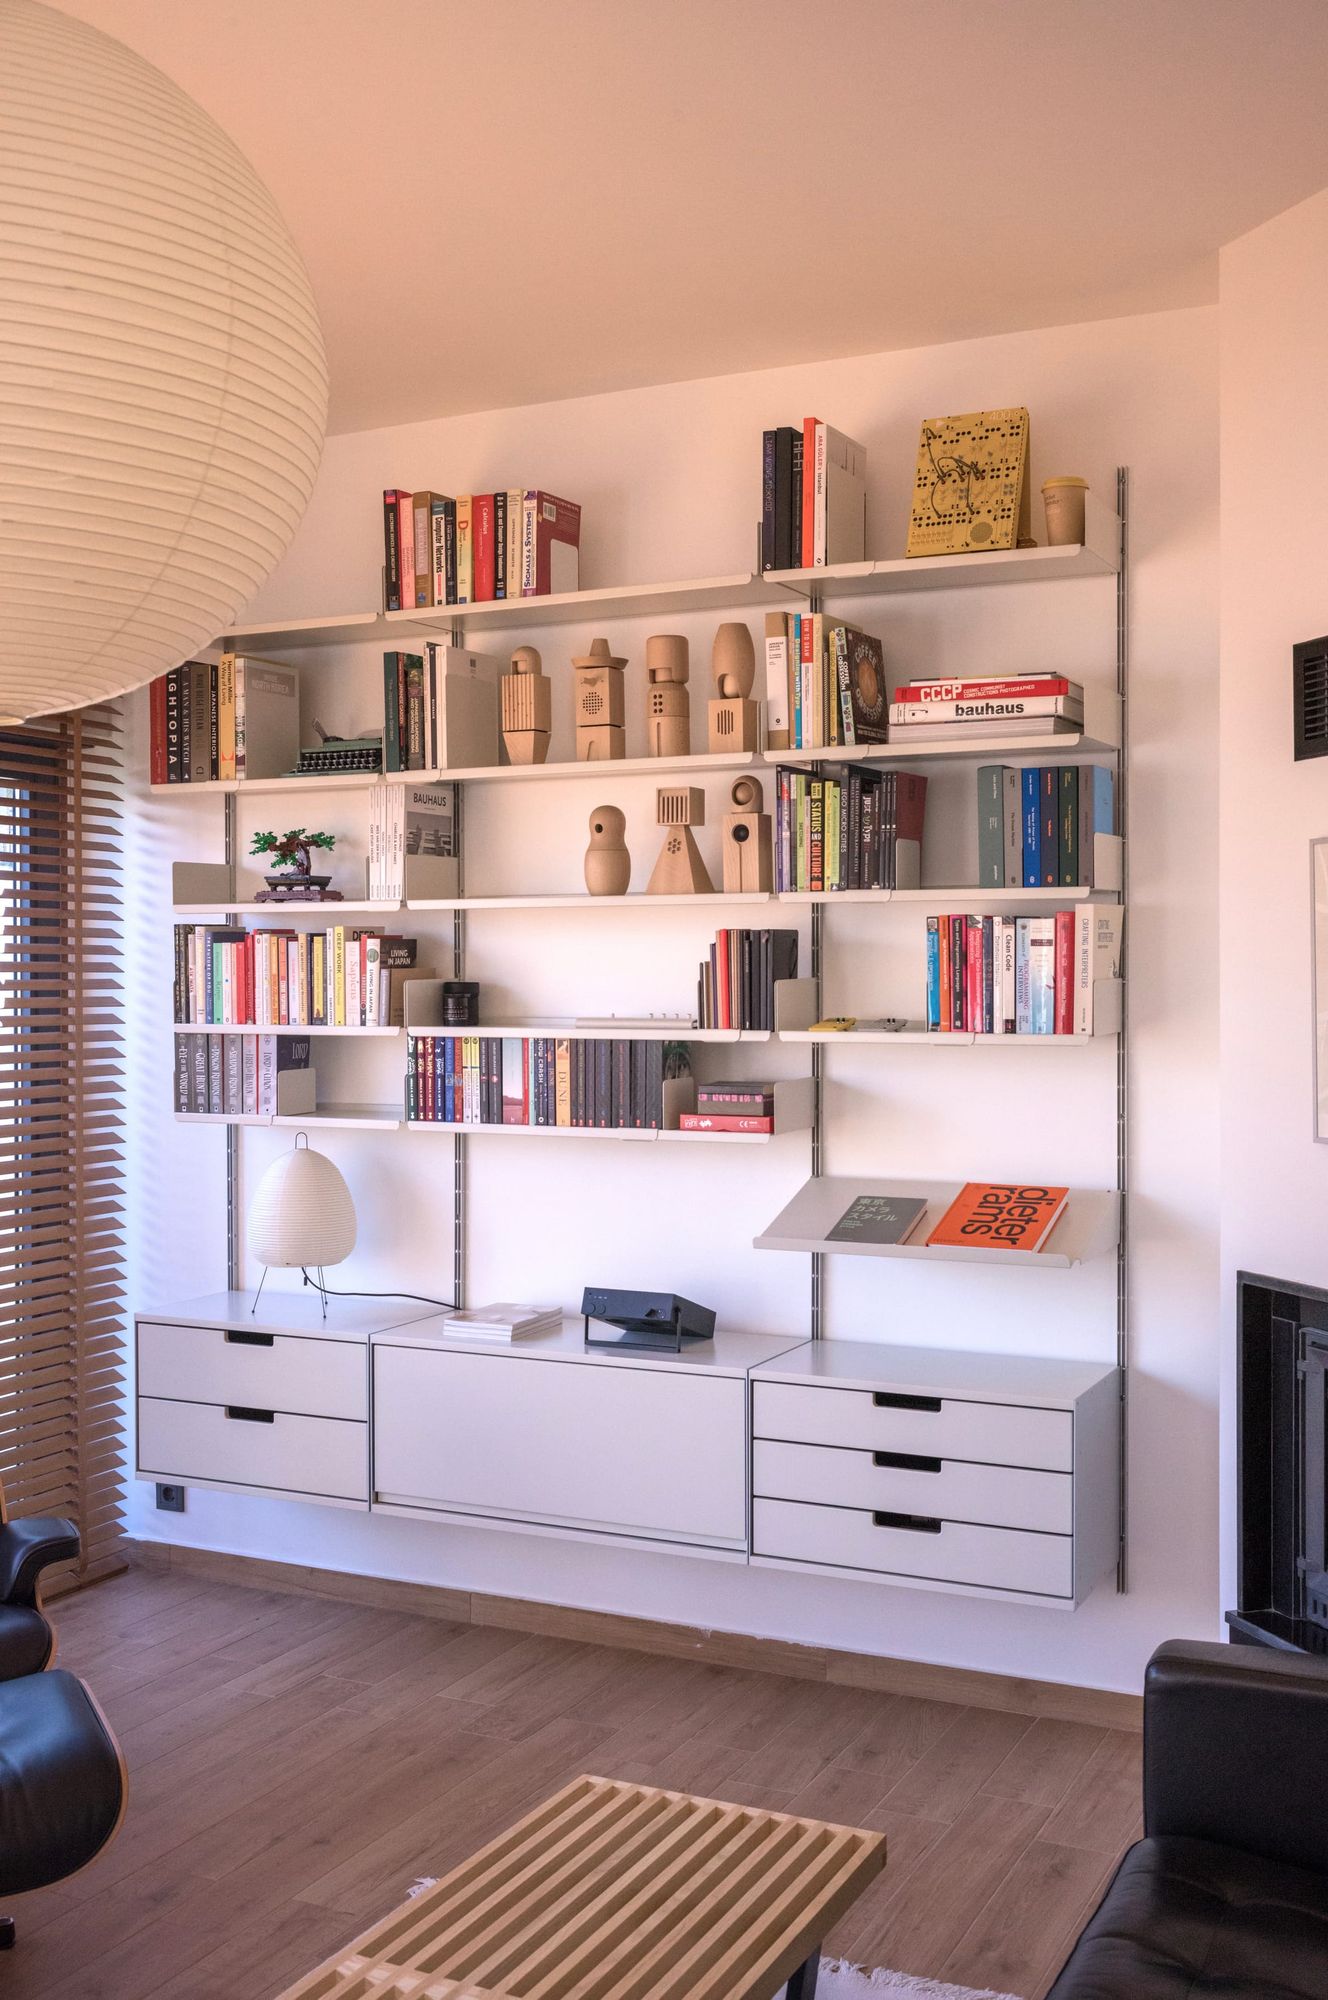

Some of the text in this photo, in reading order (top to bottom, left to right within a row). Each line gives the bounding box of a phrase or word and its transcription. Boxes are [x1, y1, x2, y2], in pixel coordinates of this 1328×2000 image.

[434, 517, 444, 573] Computer Networks
[920, 684, 962, 702] CCCP
[1000, 685, 1035, 694] PHOTOGRAPHED
[168, 675, 177, 764] IGHTOPIA
[955, 702, 1024, 716] bauhaus
[413, 792, 447, 807] BAUHAUS
[812, 802, 821, 832] STATUS
[812, 841, 821, 878] CULTURE
[348, 961, 358, 1000] Sapiens
[195, 1052, 205, 1092] GREAT HUNT
[211, 1048, 219, 1095] DRAGON REBORN
[229, 1050, 237, 1096] SHADOW RISING
[245, 1054, 254, 1068] FIRES
[264, 1052, 272, 1067] LORD
[180, 1072, 188, 1094] WORLD
[264, 1073, 272, 1090] CHAOS
[558, 1071, 566, 1105] DUNE
[960, 1187, 1017, 1235] rams
[990, 1188, 1056, 1245] dieter
